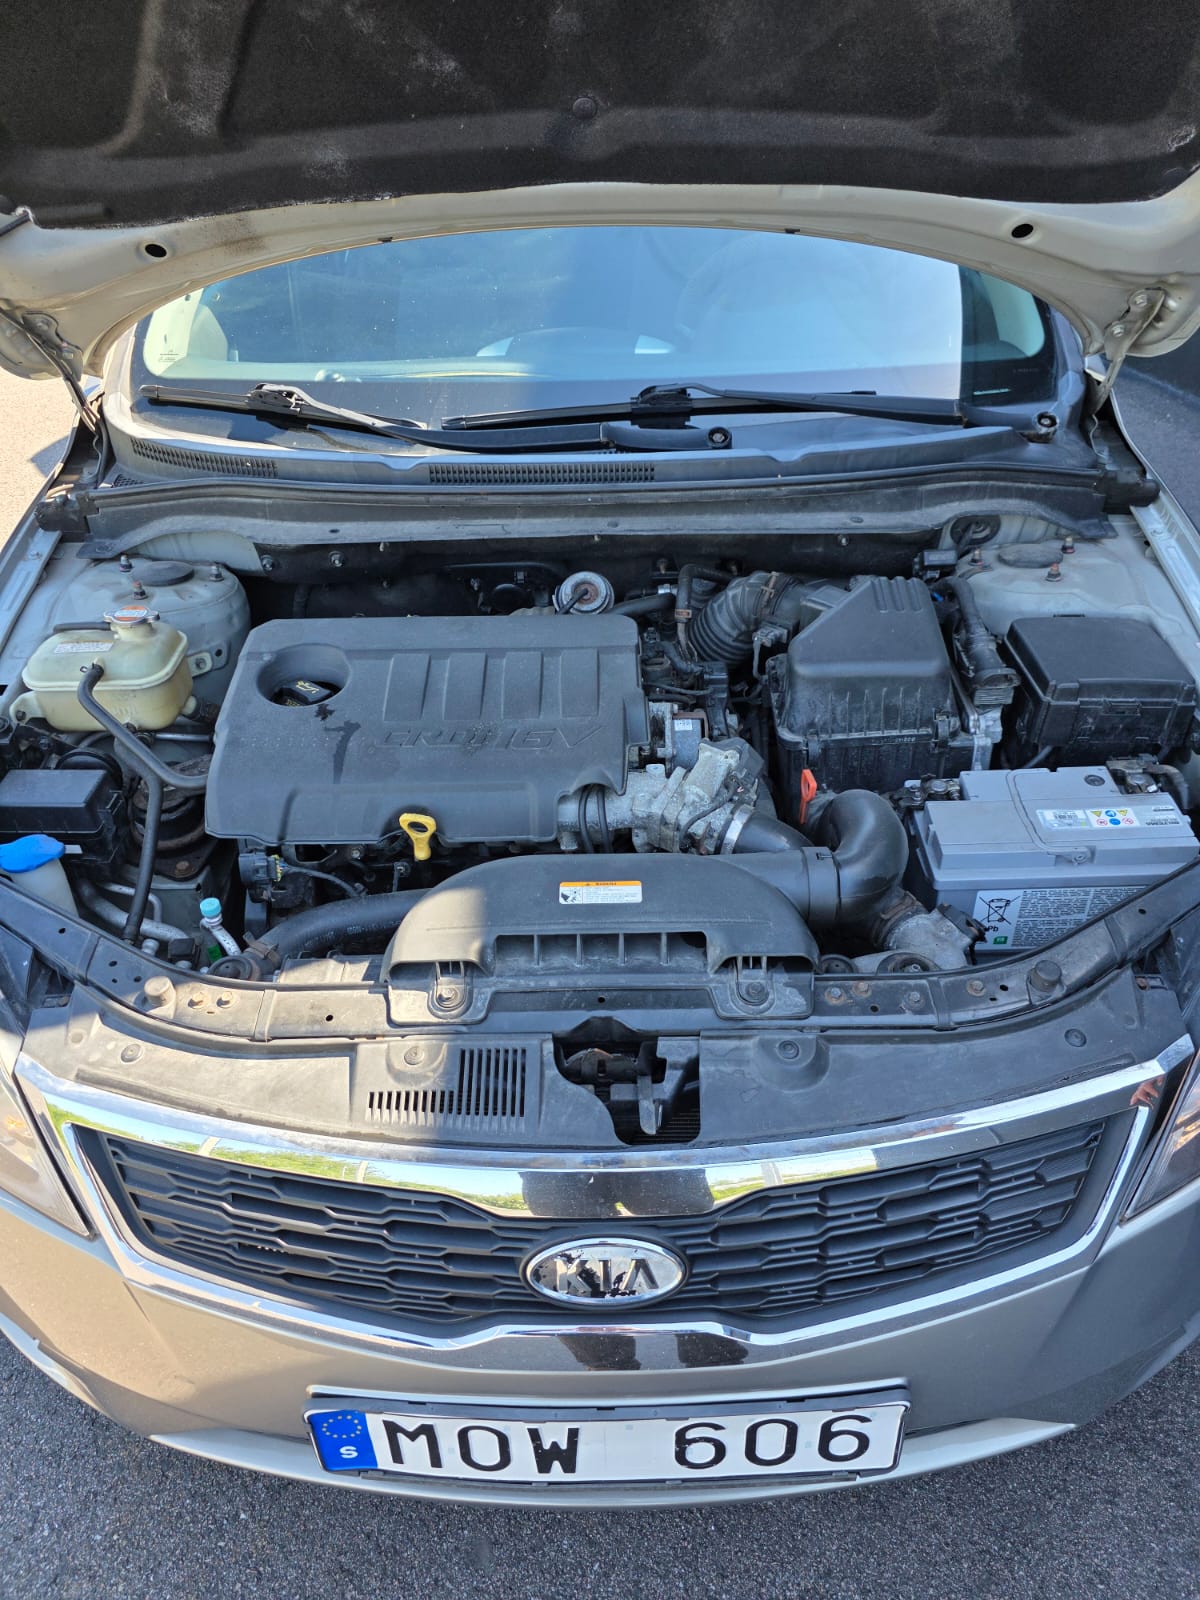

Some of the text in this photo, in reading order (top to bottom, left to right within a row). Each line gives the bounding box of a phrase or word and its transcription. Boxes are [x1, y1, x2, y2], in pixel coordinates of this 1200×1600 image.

[554, 1258, 660, 1295] KIA
[340, 1446, 358, 1459] S
[382, 1414, 873, 1475] MOW 606
